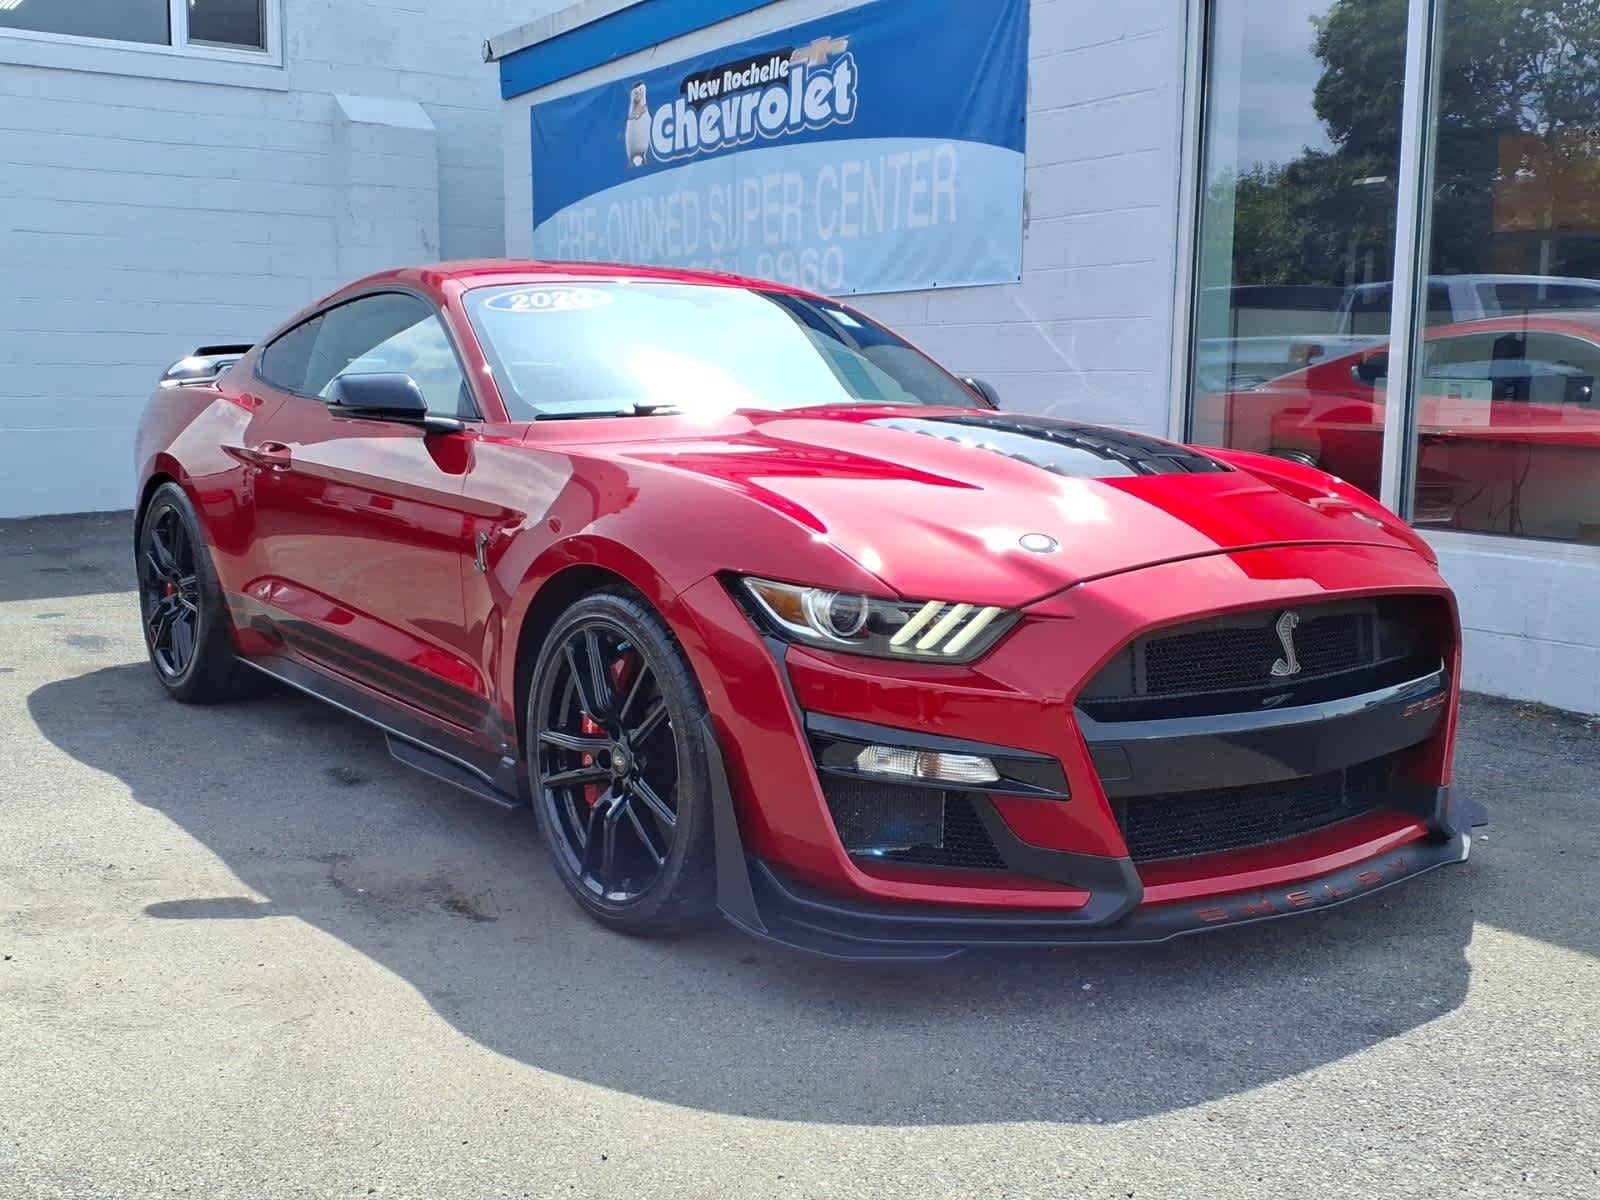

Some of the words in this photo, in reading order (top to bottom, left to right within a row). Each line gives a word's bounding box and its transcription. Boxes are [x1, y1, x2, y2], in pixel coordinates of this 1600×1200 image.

[652, 59, 851, 154] Chevrolet
[687, 77, 721, 102] New
[723, 57, 789, 92] Rochelle
[556, 189, 700, 261] PRE-OWNED
[708, 169, 804, 250] SUPER
[815, 143, 957, 240] CENTER
